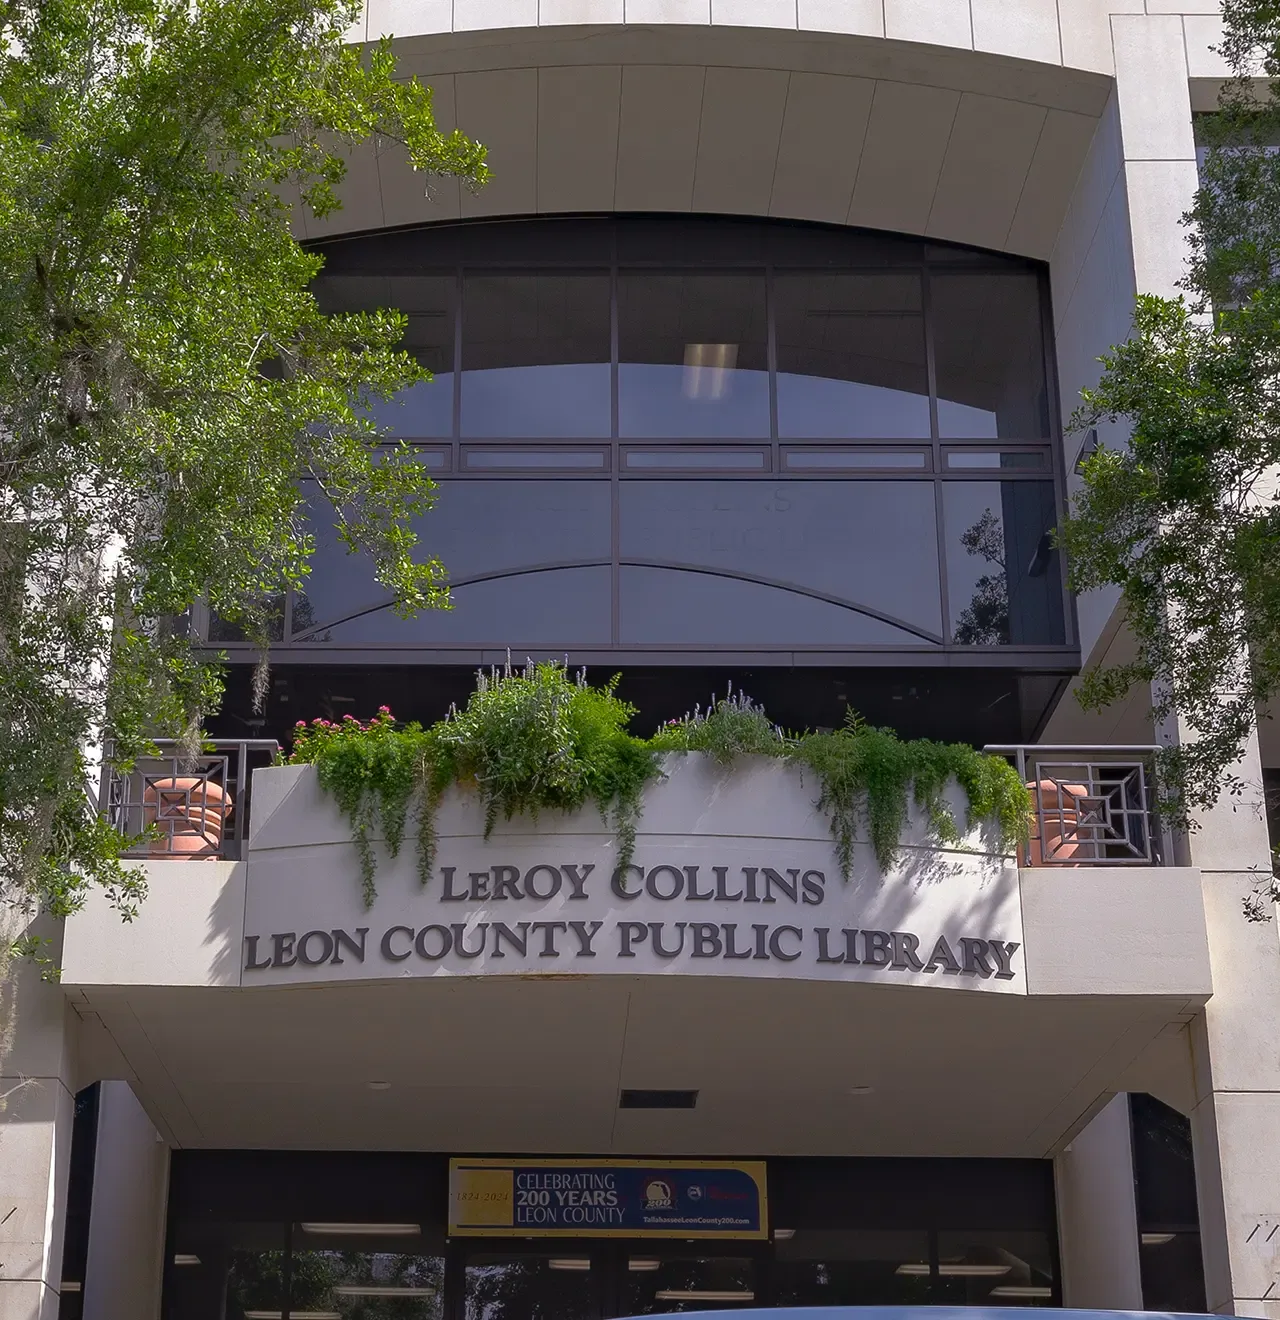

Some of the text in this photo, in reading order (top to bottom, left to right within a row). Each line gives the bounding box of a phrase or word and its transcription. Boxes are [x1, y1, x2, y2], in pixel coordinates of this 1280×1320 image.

[610, 863, 827, 905] COLLINS
[244, 920, 1022, 980] LEON COUNTY PUBLIC LIBRARY
[516, 1173, 615, 1190] CELEBRATING
[456, 1192, 509, 1202] 1824-2024
[517, 1190, 618, 1207] 200 YEARS
[646, 1199, 672, 1207] 200
[517, 1206, 626, 1224] LEON COUNTY
[643, 1216, 750, 1225] TallahasseeLeonCounty200.com
